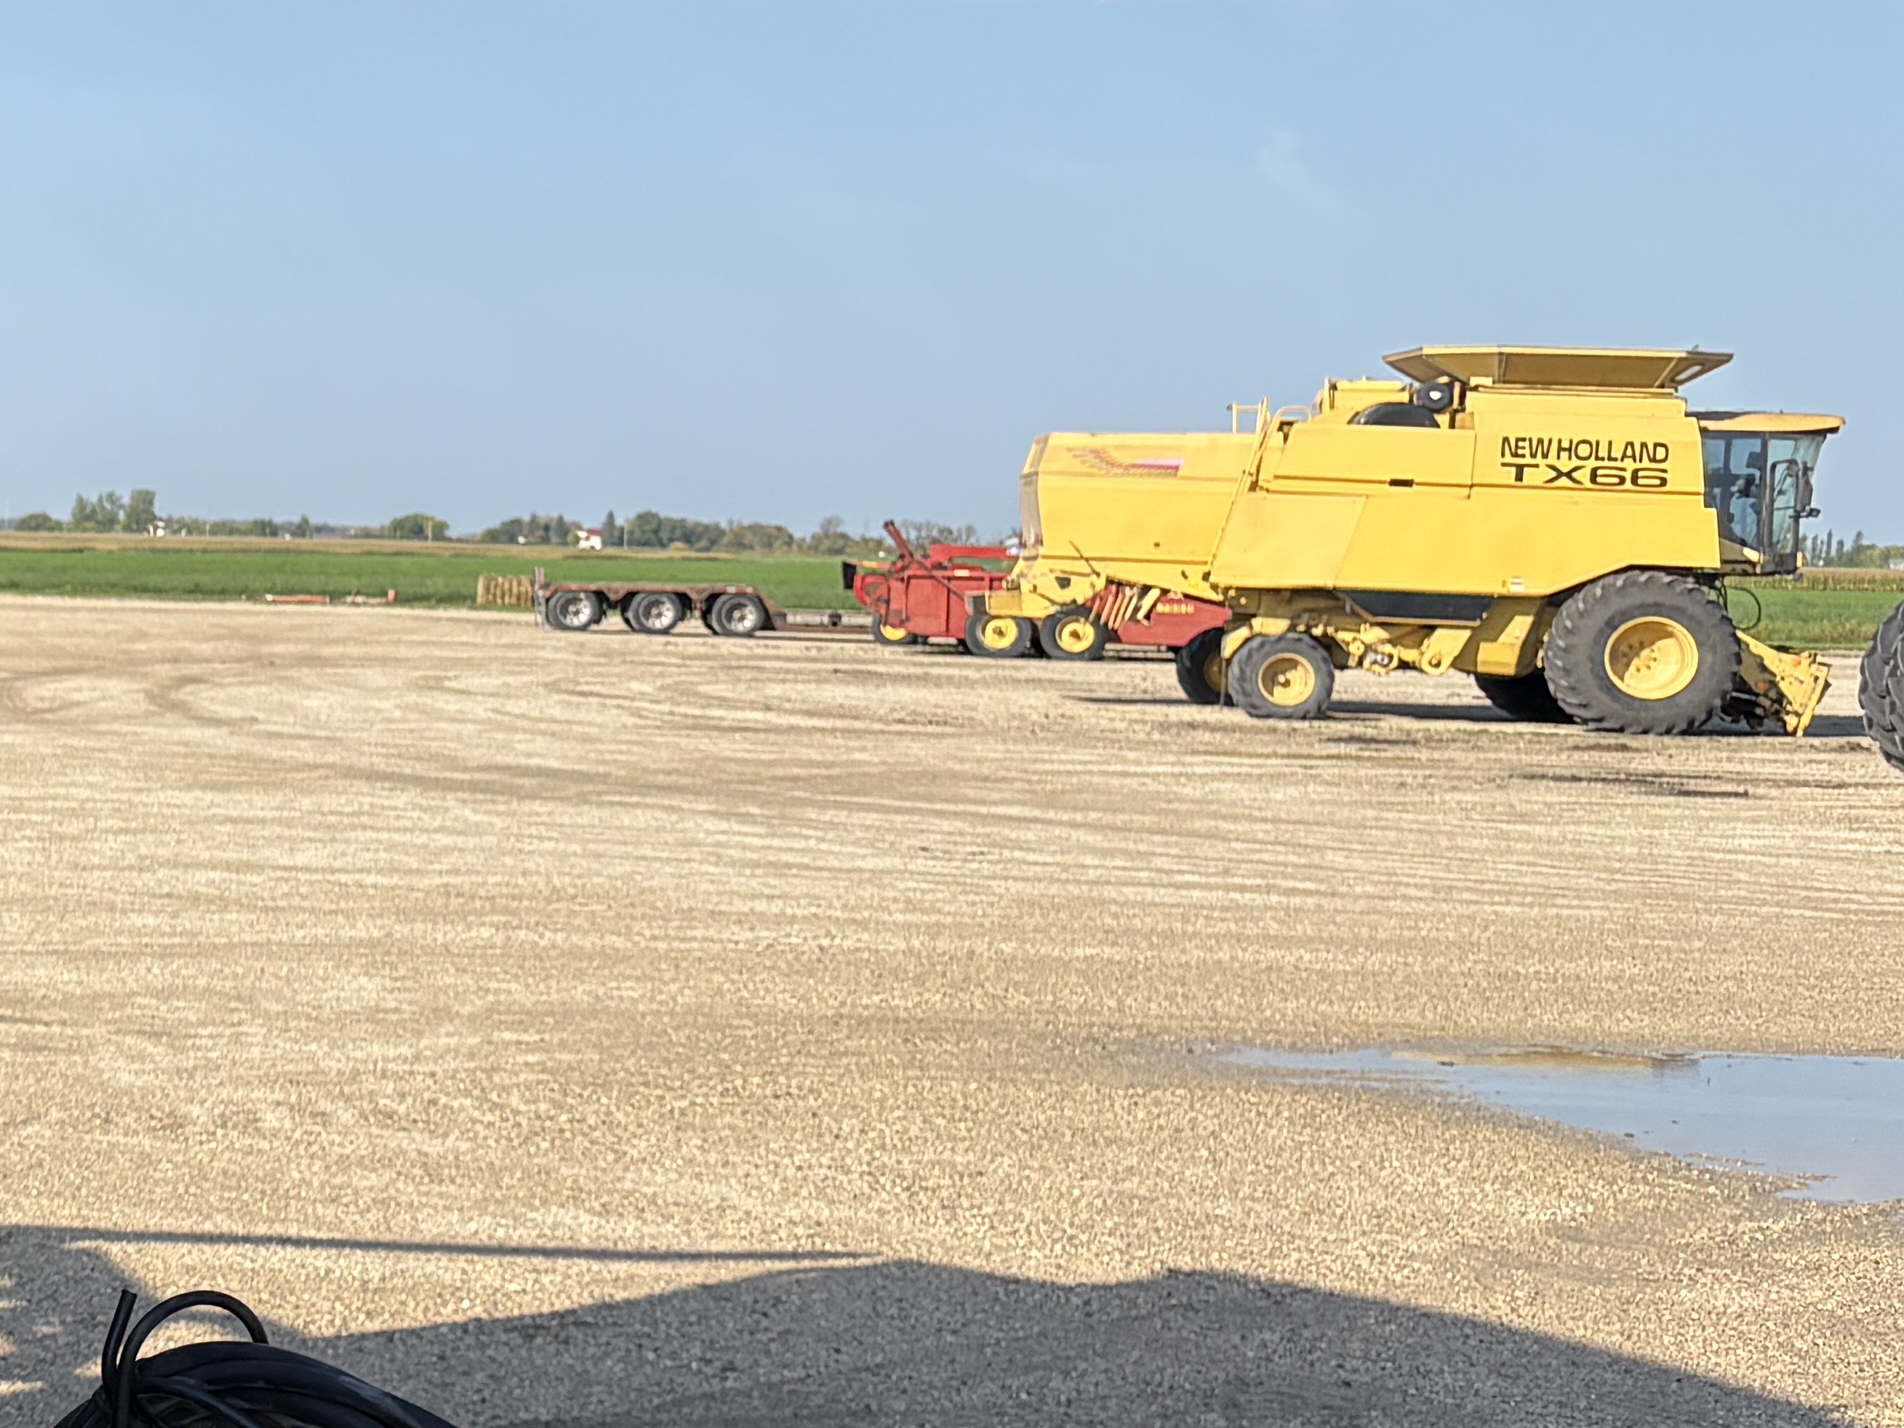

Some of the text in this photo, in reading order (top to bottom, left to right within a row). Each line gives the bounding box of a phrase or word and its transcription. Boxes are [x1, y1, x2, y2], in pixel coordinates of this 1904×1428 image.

[1500, 435, 1670, 464] NEW HOLLAND
[1500, 461, 1669, 489] TX66
